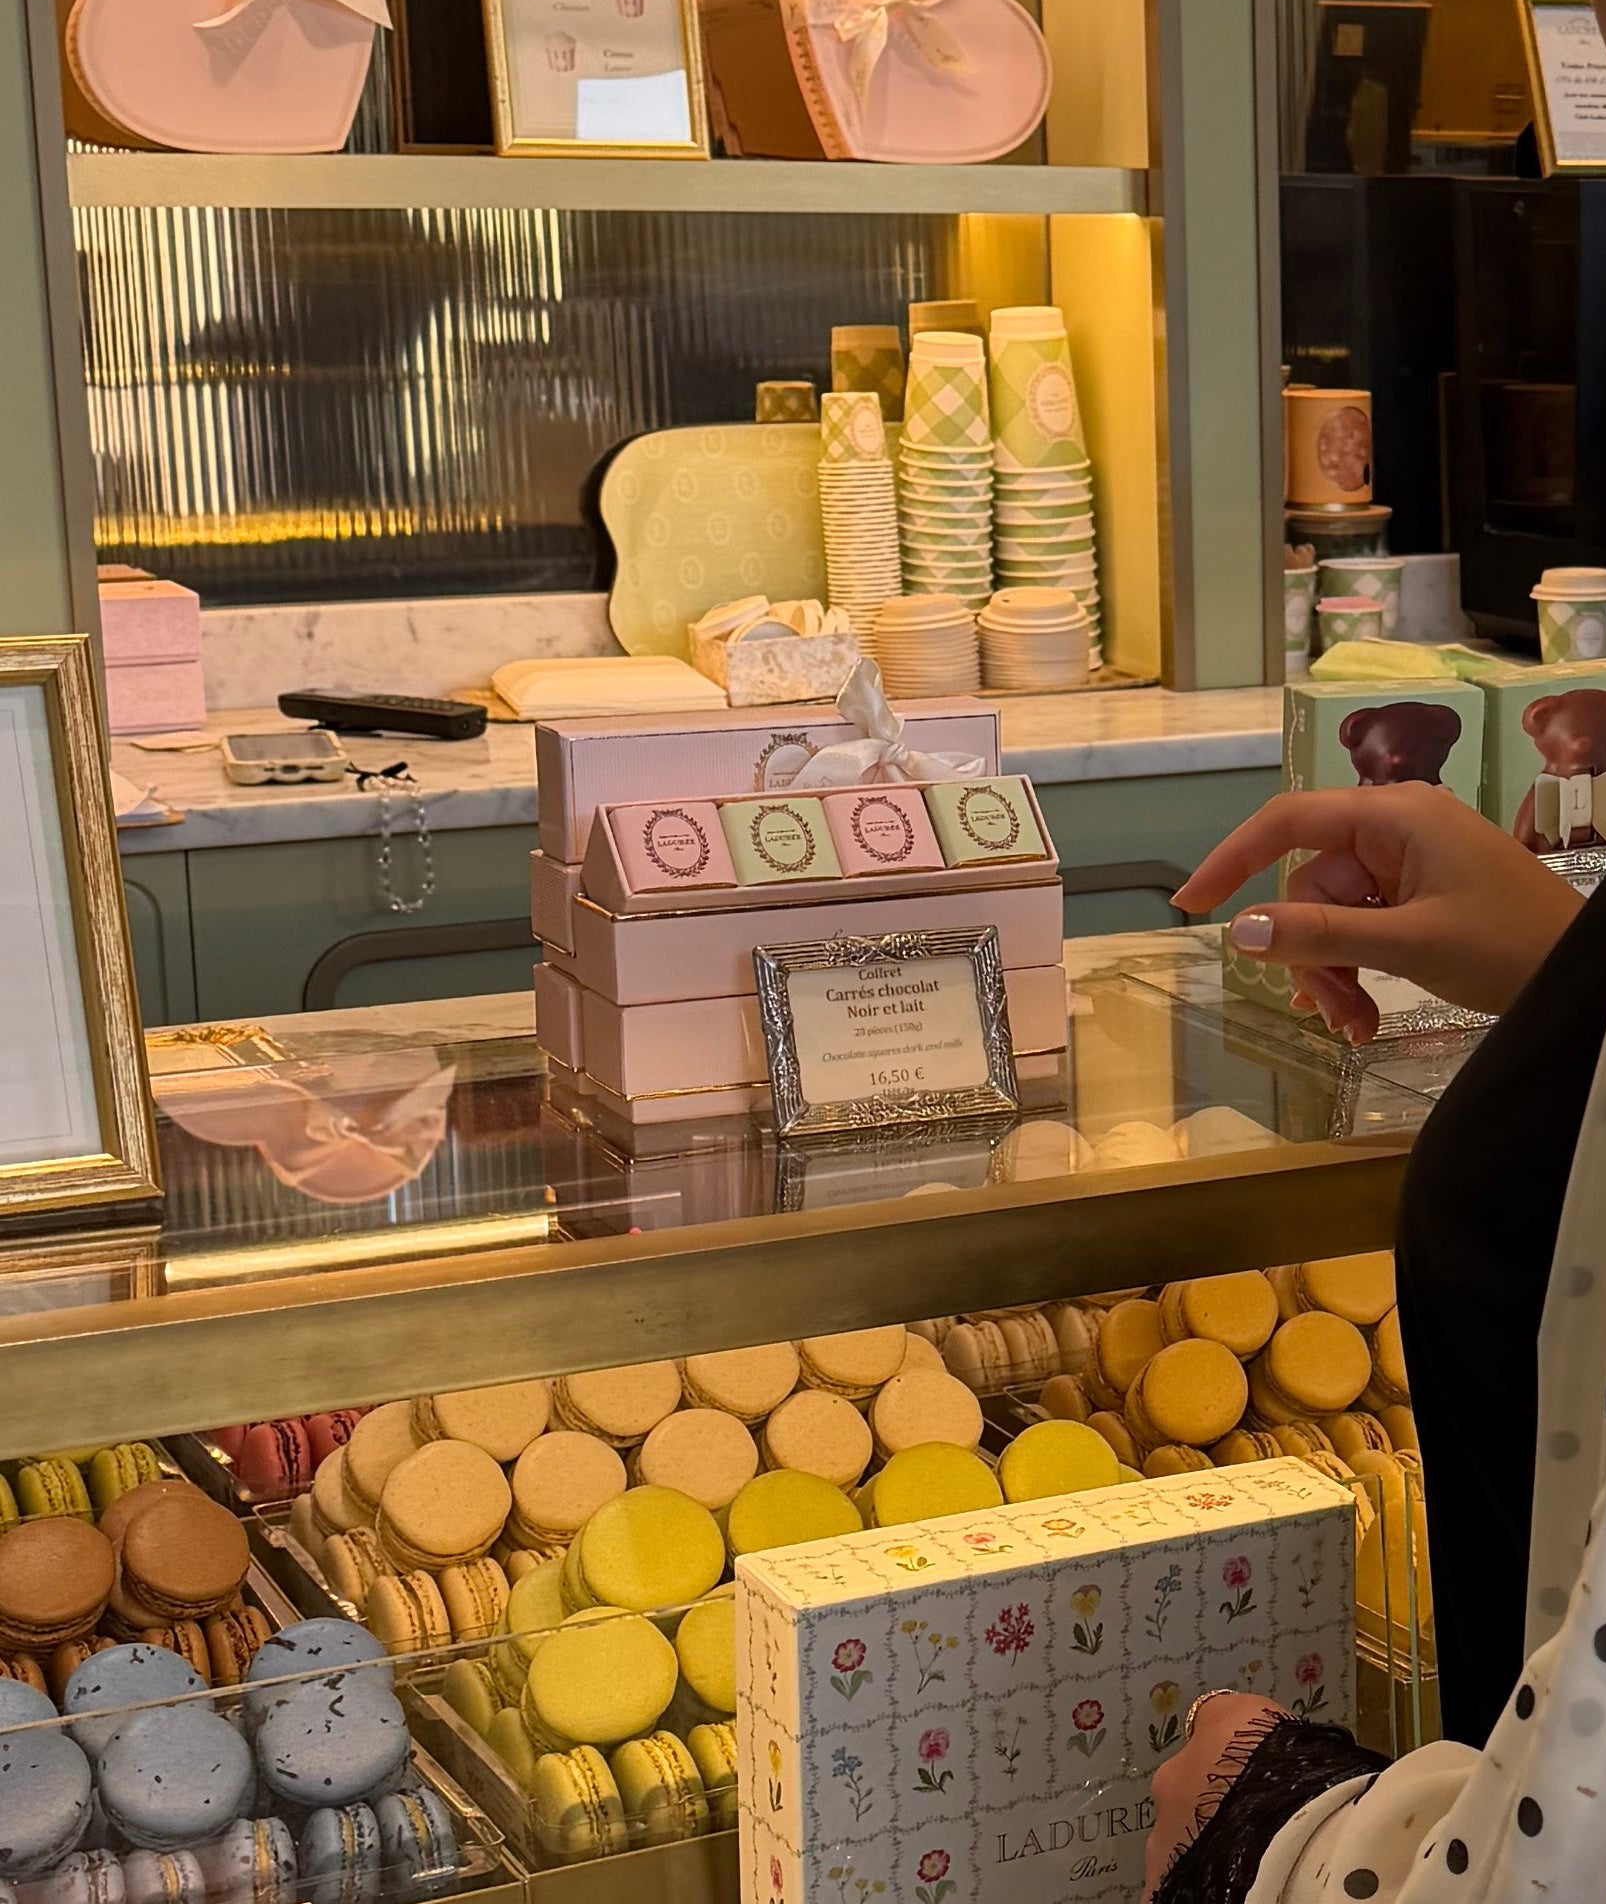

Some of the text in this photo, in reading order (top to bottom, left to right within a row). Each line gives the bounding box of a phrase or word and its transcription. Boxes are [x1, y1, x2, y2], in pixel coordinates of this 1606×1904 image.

[1574, 789, 1586, 810] L
[858, 967, 902, 981] Coffret
[826, 980, 940, 1002] Carrés chocolat
[847, 1000, 925, 1019] Noir et lait
[871, 1066, 925, 1086] 16,50 €
[996, 1796, 1157, 1864] LADURÉ
[1070, 1855, 1119, 1881] Paris
